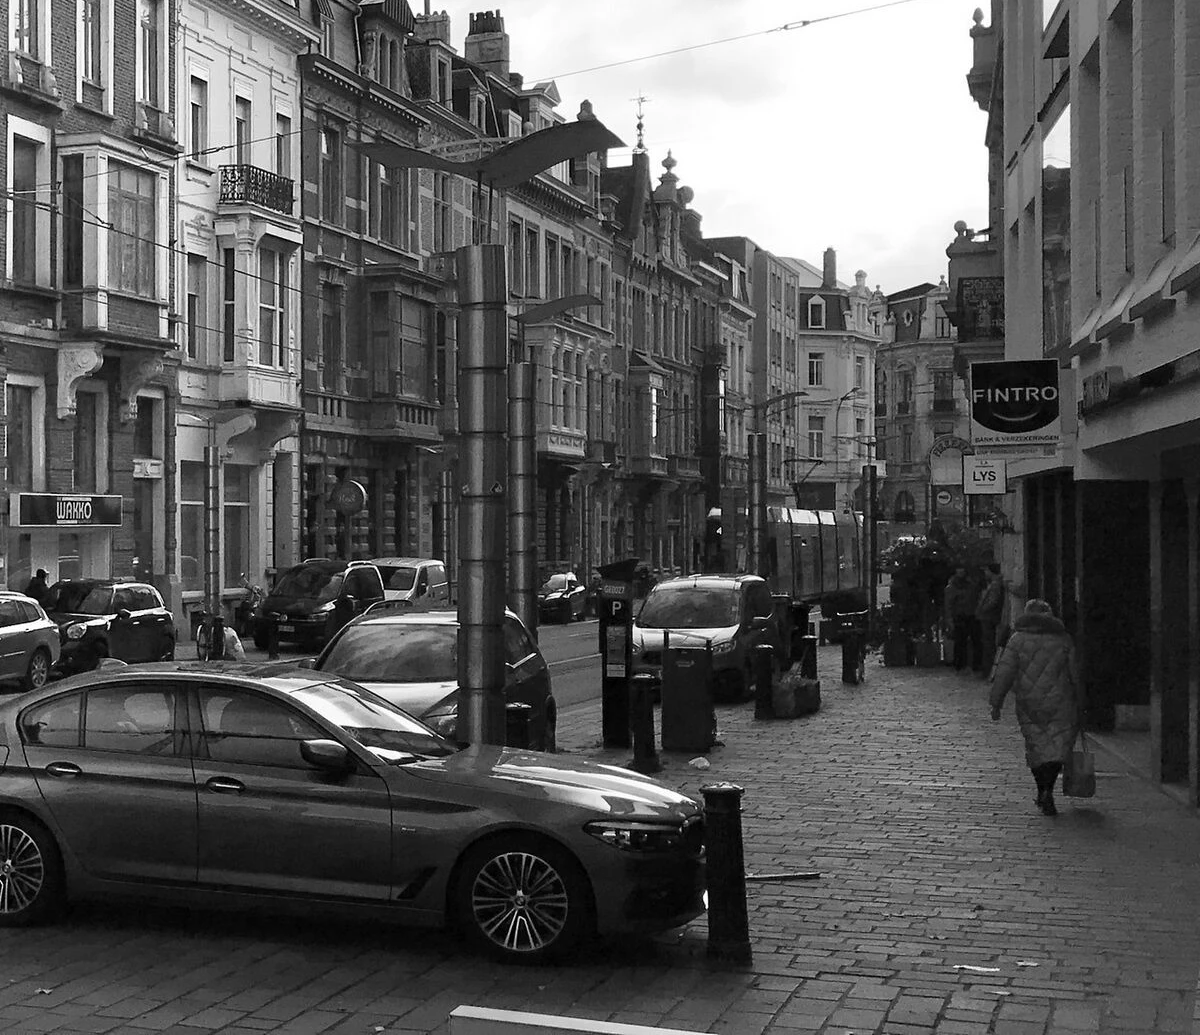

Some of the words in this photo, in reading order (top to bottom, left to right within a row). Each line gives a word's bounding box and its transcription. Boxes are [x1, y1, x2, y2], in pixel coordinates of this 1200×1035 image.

[973, 386, 1058, 404] FINTRO
[1001, 435, 1060, 443] VERZEKERINGEN
[972, 471, 997, 482] LYS
[56, 501, 92, 520] WAKKO
[716, 526, 722, 535] 4
[612, 601, 622, 616] P
